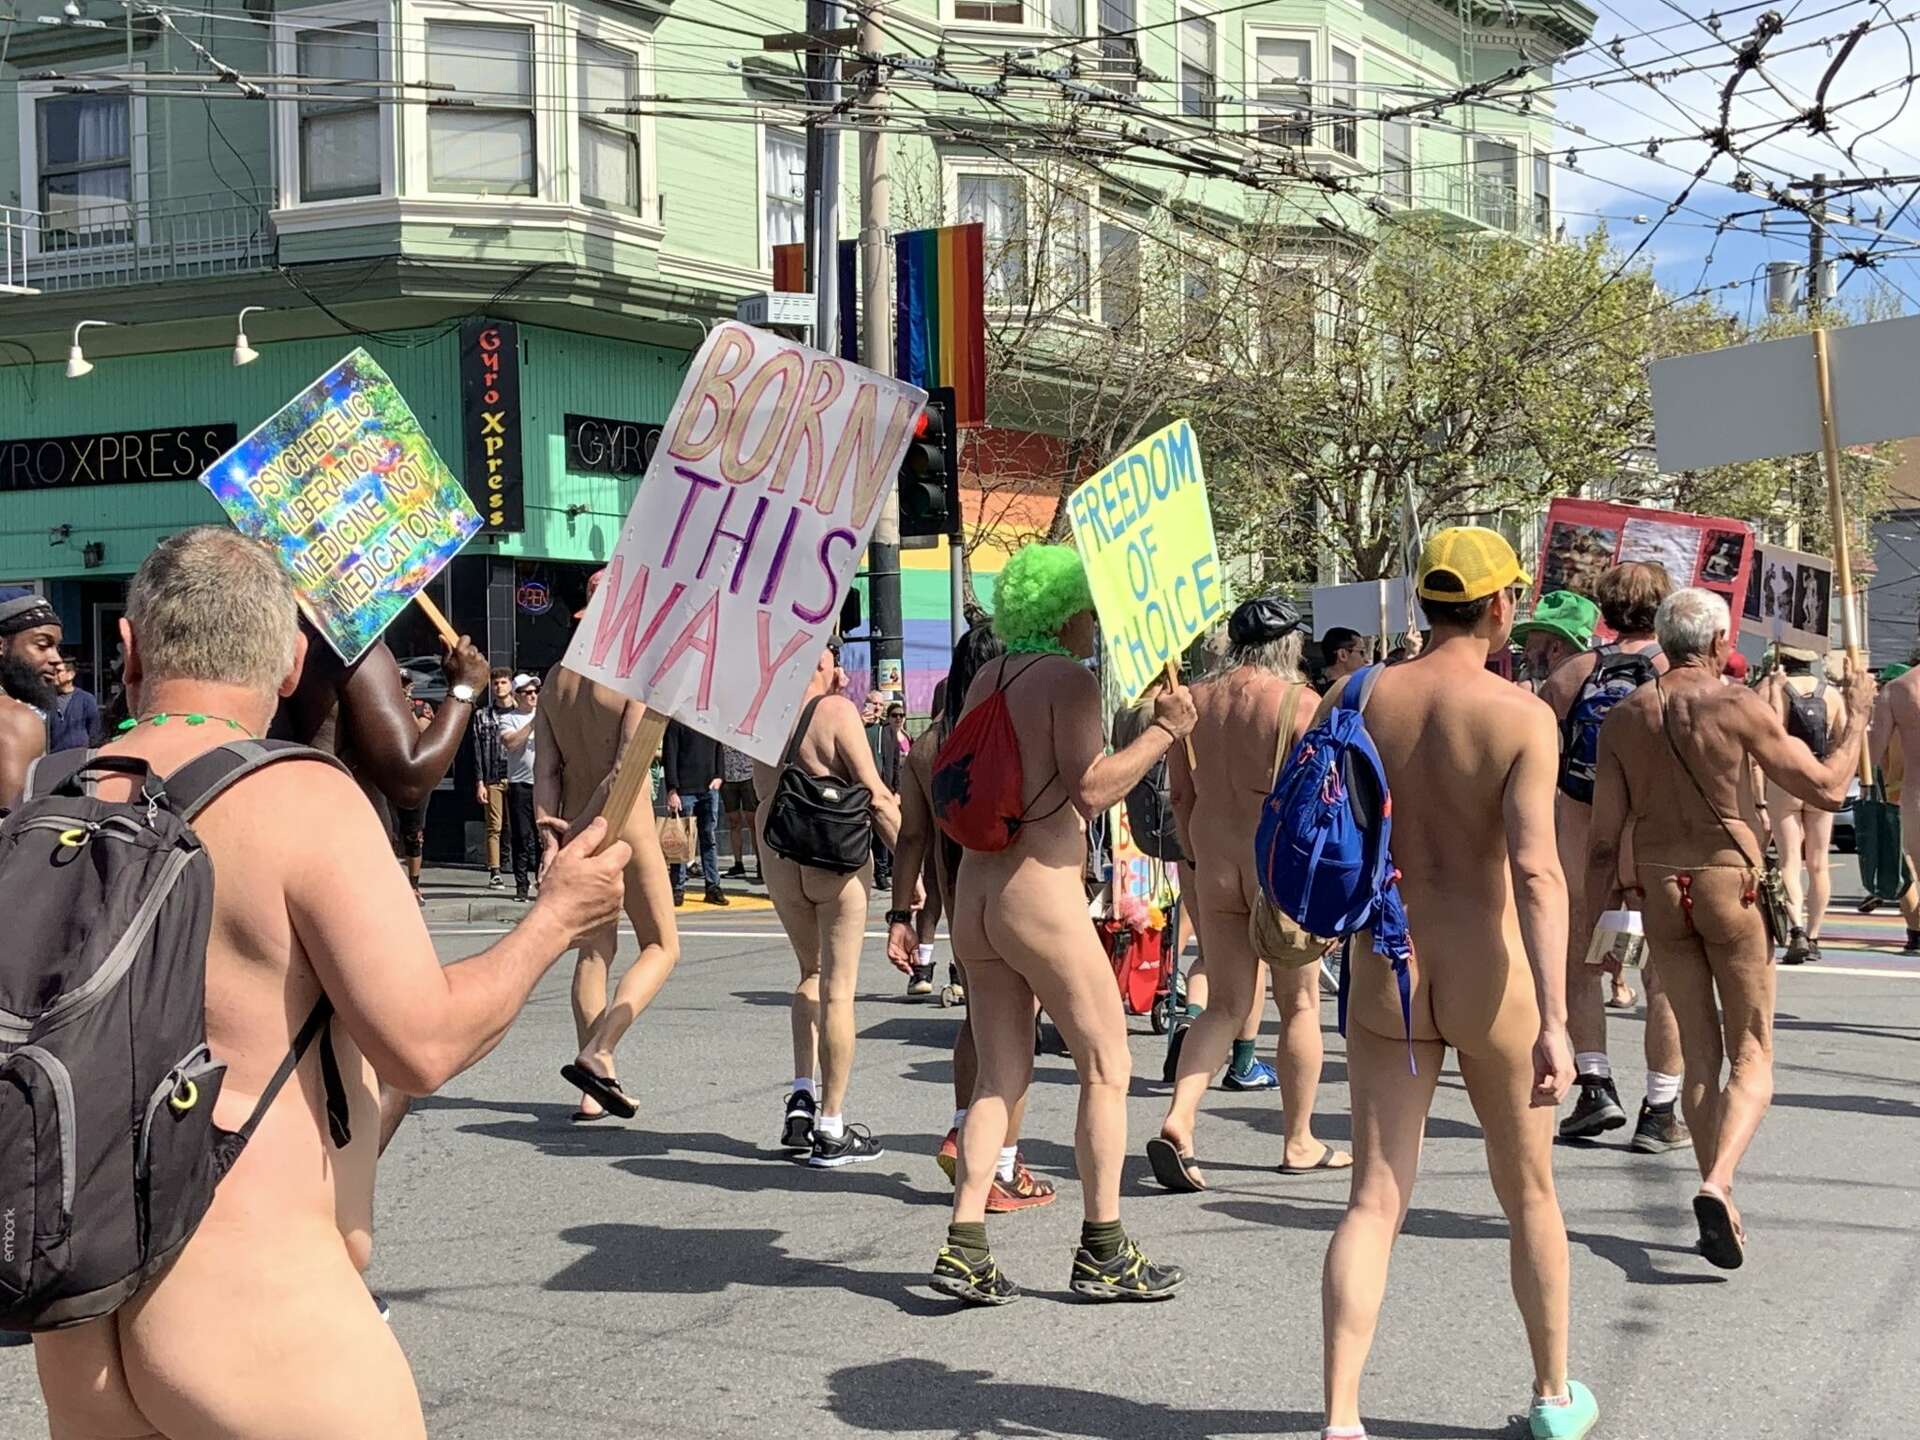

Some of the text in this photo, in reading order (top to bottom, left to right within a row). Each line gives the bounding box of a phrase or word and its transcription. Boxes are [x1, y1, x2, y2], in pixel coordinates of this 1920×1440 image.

[248, 392, 372, 505] PSYCHEDELIC
[667, 327, 920, 529] BORN
[1070, 422, 1197, 562] FREEDOM
[294, 453, 428, 586] MEDICINE NOT
[330, 501, 441, 614] MEDICATION
[661, 466, 857, 625] THIS
[1126, 524, 1158, 601] OF
[588, 555, 813, 736] WAY
[1112, 553, 1221, 698] CHOICE
[2, 1207, 16, 1262] embark
